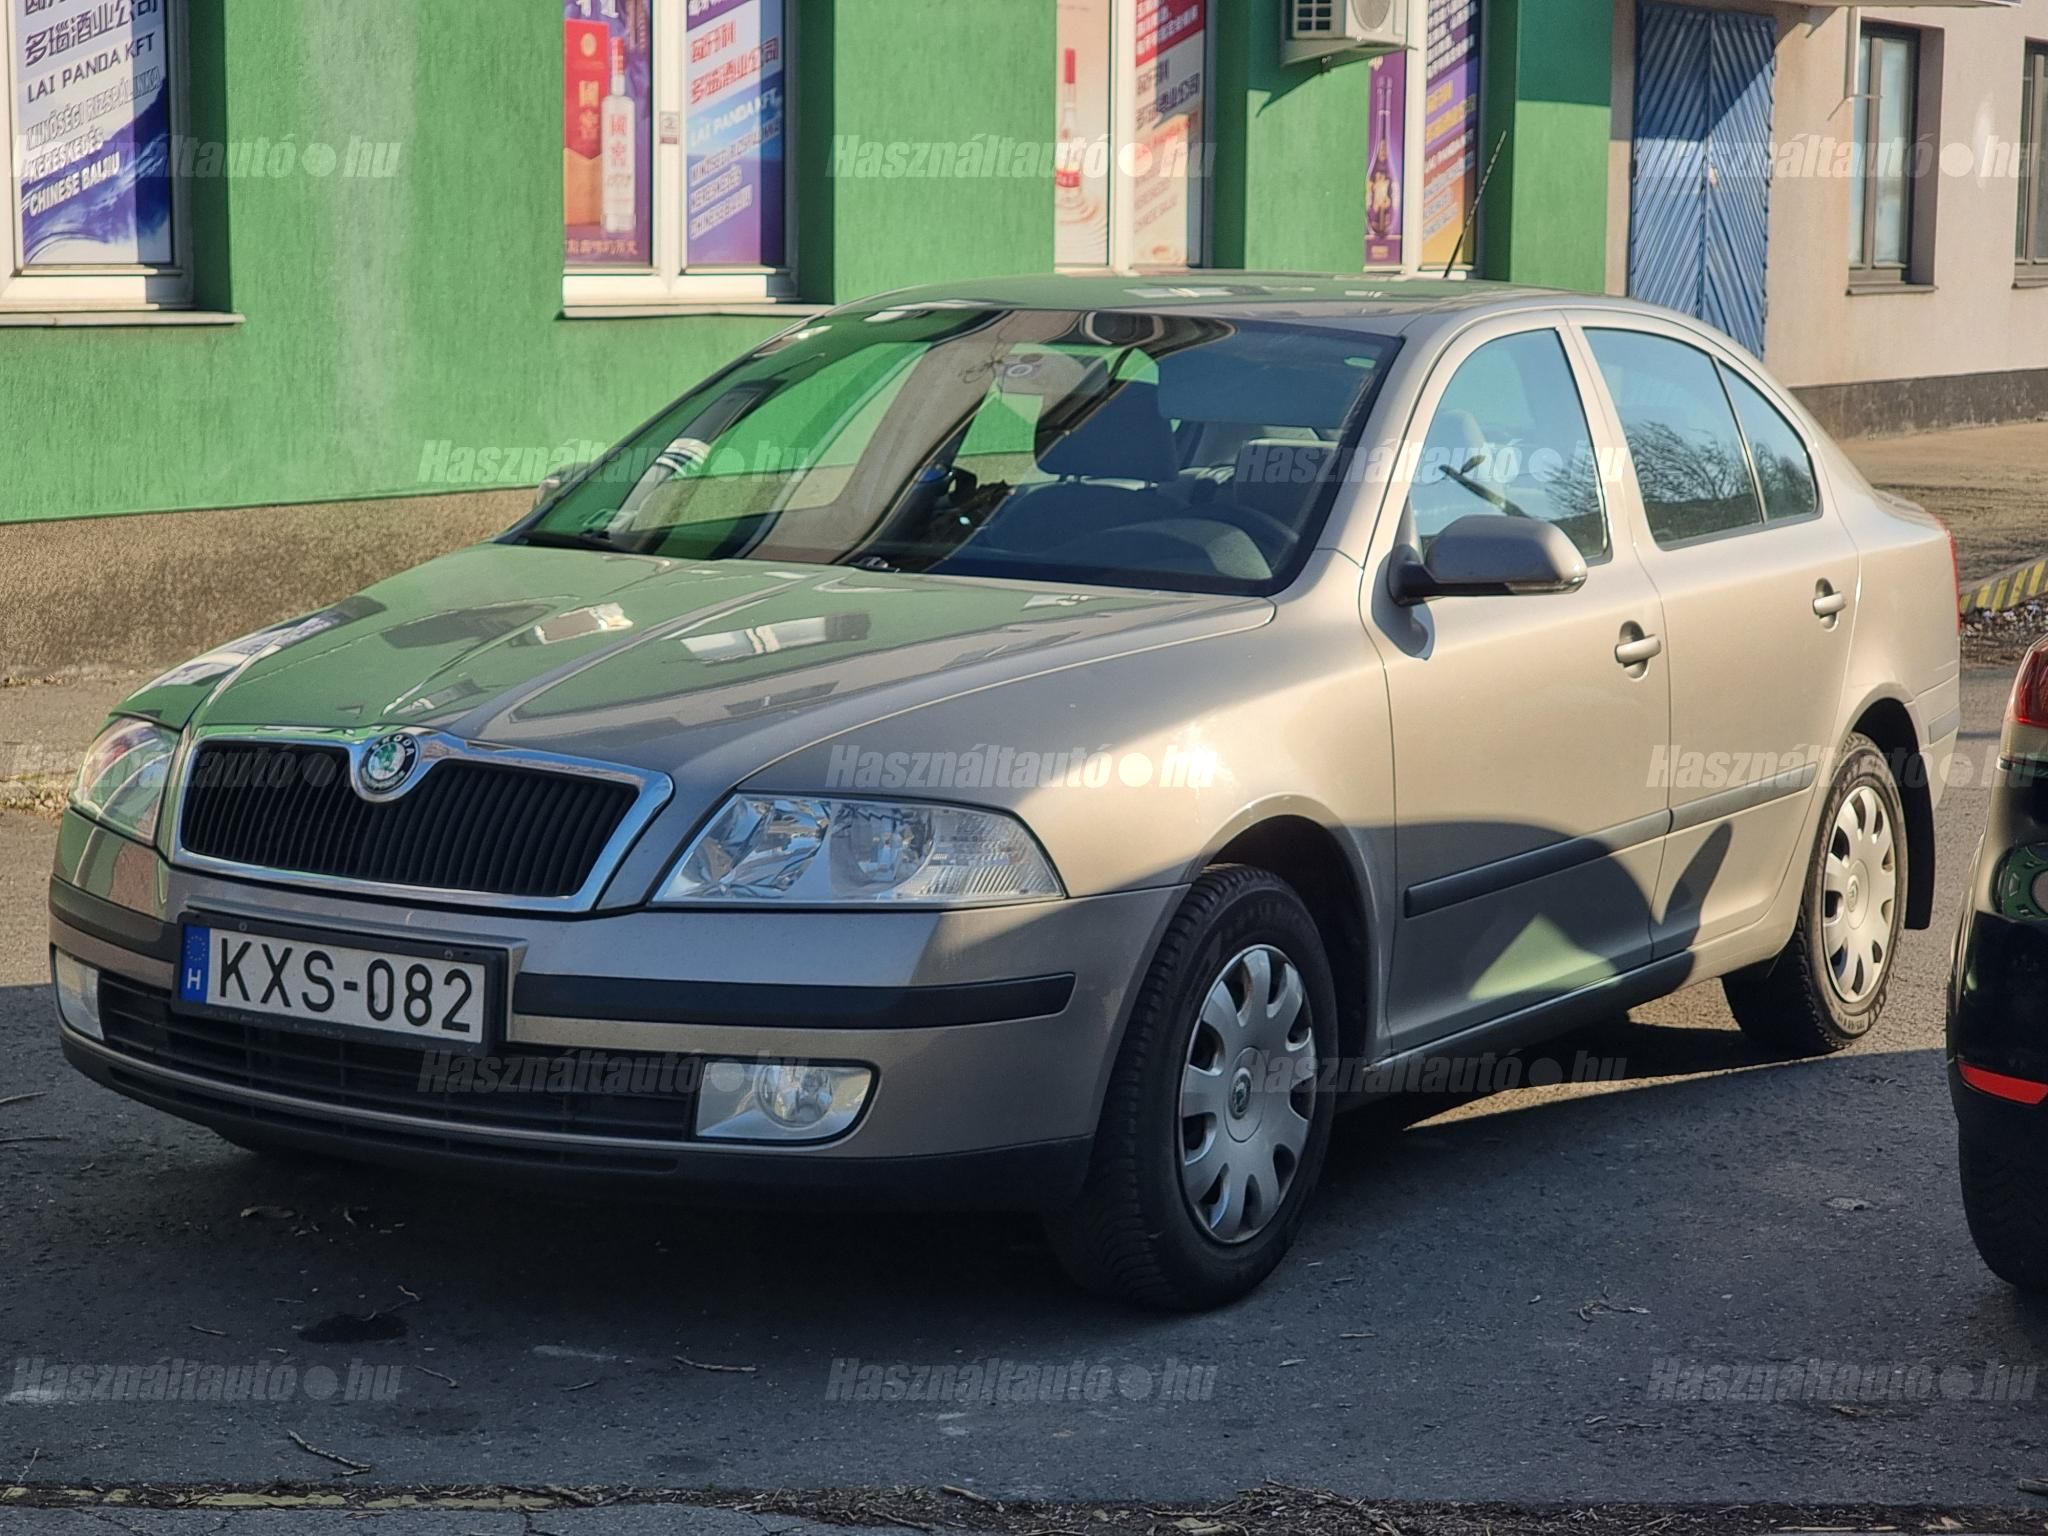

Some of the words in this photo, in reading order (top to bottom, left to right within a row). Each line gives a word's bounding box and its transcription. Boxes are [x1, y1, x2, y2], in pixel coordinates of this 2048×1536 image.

[28, 74, 56, 103] LAI
[62, 48, 121, 88] PANDA
[125, 32, 156, 61] KFT
[29, 174, 81, 217] CHINESE
[187, 968, 200, 991] H
[220, 937, 473, 1033] KXS-082
